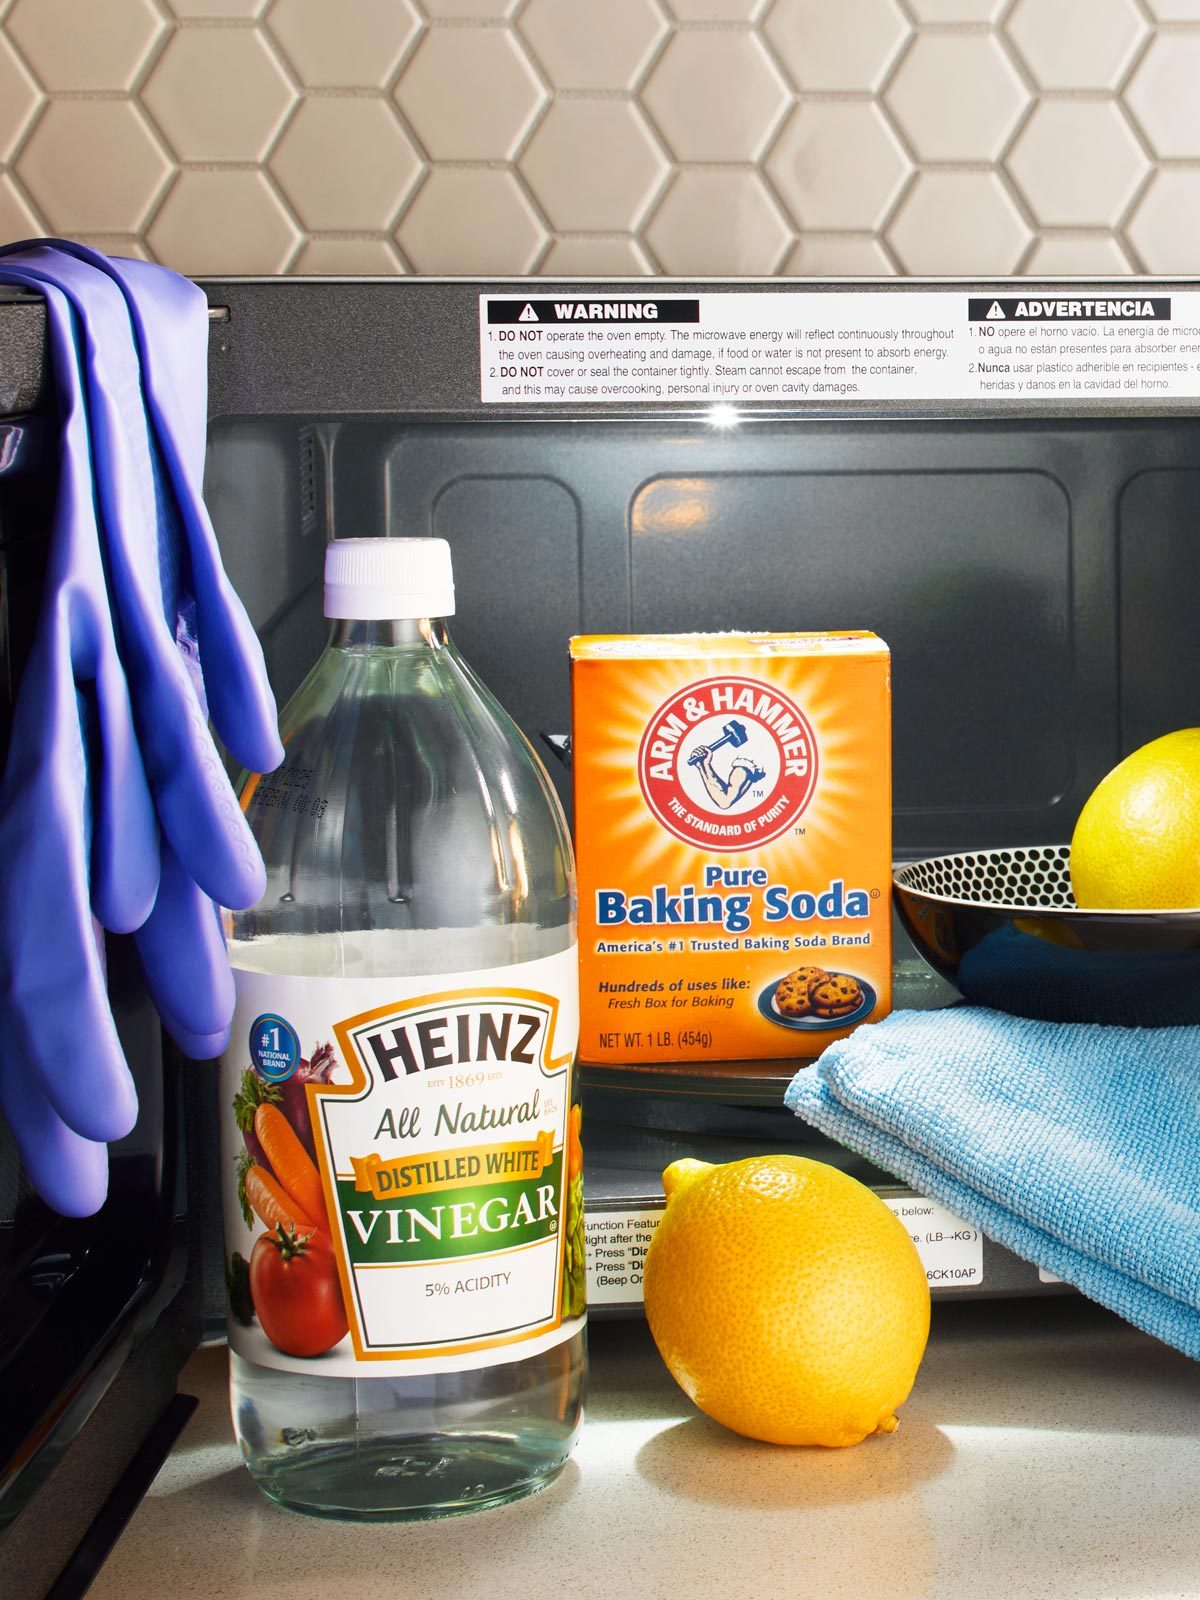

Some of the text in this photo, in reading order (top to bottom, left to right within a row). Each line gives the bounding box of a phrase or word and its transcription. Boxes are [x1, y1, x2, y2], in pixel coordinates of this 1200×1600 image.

[553, 302, 659, 320] WARNING
[1014, 300, 1156, 317] ADVERTENCIA
[498, 329, 516, 342] DO
[519, 329, 544, 342] NOT
[546, 330, 585, 344] operate
[587, 330, 604, 341] the
[606, 332, 632, 341] oven
[634, 330, 667, 343] empty.
[669, 329, 690, 341] The
[692, 329, 747, 341] microwave
[749, 331, 784, 343] energy
[786, 329, 802, 340] will
[805, 328, 835, 340] reflect
[837, 329, 899, 342] continuously
[901, 328, 954, 342] throughout
[498, 346, 949, 363] the oven causing overheating and damage, if food or water is not present to absorb energy.
[501, 384, 522, 396] and
[523, 383, 542, 395] this
[544, 385, 566, 398] may
[568, 385, 599, 395] cause
[667, 382, 711, 396] personal
[712, 382, 740, 396] injury
[741, 384, 753, 393] or
[754, 384, 779, 393] oven
[781, 381, 810, 395] cavity
[812, 381, 861, 395] damages.
[979, 378, 1171, 393] heridas y danos en la cavidad del horno.
[650, 686, 808, 782] ARM & HAMMER
[668, 795, 790, 836] THE STANDARD OF PURITY
[706, 866, 767, 887] Pure
[597, 881, 870, 932] Baking Soda
[597, 933, 870, 953] America's #1 Trusted Baking Soda Brand
[598, 978, 751, 993] Hundreds of uses like:
[608, 995, 735, 1009] Fresh Box for Baking
[261, 1027, 280, 1051] #1
[367, 1012, 541, 1083] HEINZ
[599, 1030, 713, 1049] NET WT. 1 LB. (454g)
[258, 1050, 291, 1061] NATIONAL
[263, 1058, 286, 1068] BRAND
[448, 1071, 485, 1089] 1869
[373, 1088, 540, 1140] All Natural
[376, 1150, 540, 1193] DISTILLED WHITE
[347, 1184, 558, 1245] VINEGAR
[584, 1220, 624, 1231] unction
[902, 1206, 934, 1216] below:
[610, 1234, 633, 1244] after
[636, 1233, 652, 1242] the
[595, 1248, 625, 1258] Press
[595, 1262, 625, 1272] Press
[425, 1271, 511, 1297] 5% ACIDITY
[596, 1275, 627, 1287] (Beep
